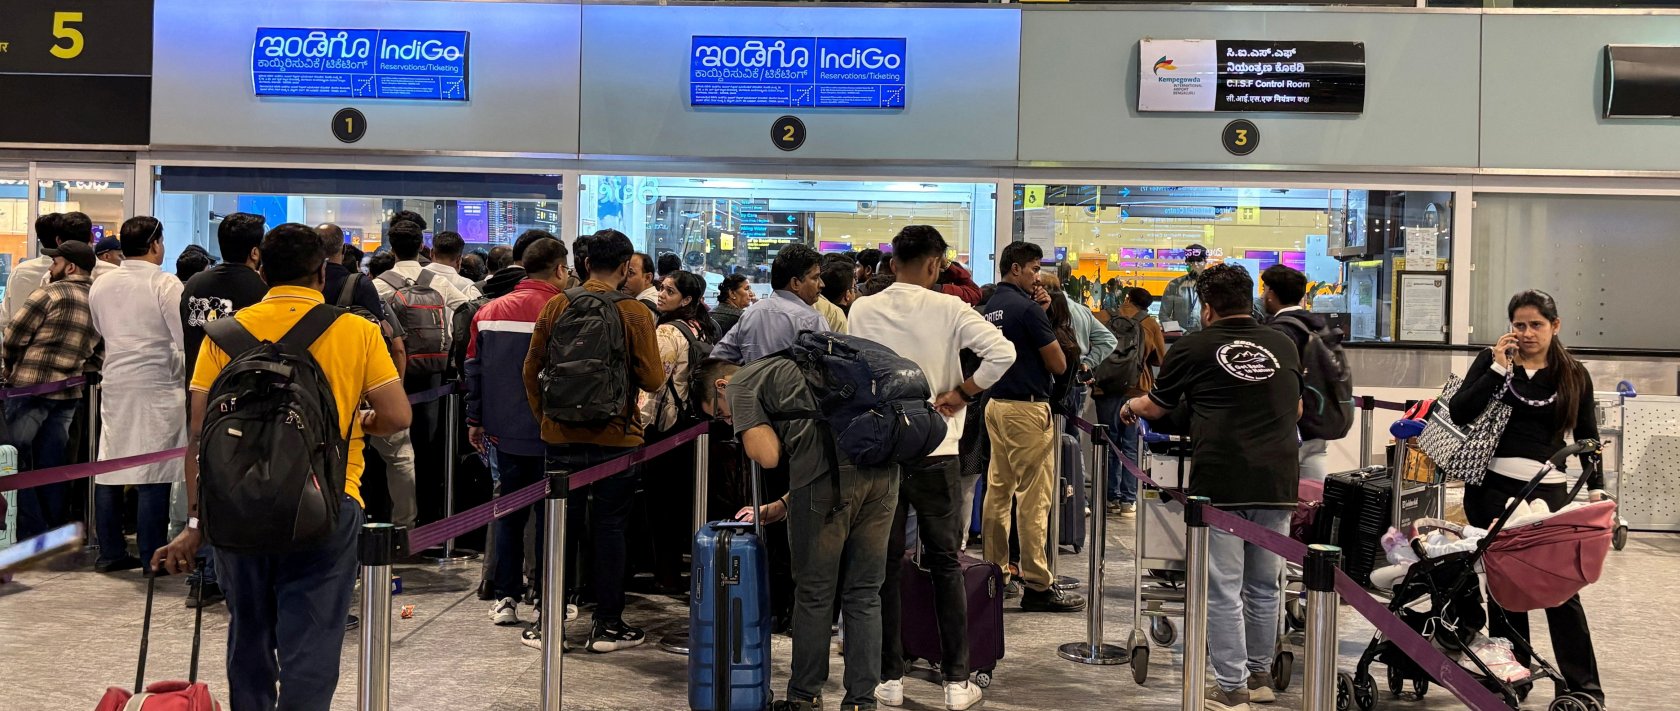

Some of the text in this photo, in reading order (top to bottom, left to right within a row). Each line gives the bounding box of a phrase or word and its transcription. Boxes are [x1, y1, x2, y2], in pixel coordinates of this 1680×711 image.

[49, 11, 84, 59] 5
[380, 38, 460, 61] IndiGo
[820, 47, 901, 69] IndiGo
[380, 62, 459, 73] Reservations/Ticketing
[820, 71, 900, 82] Reservations/Ticketing
[1158, 76, 1201, 84] Kempegowda
[1226, 79, 1311, 88] C.I.S.F Control Room
[345, 117, 353, 134] 1
[782, 125, 795, 141] 2
[1234, 129, 1248, 146] 3
[984, 309, 1004, 322] ORTER
